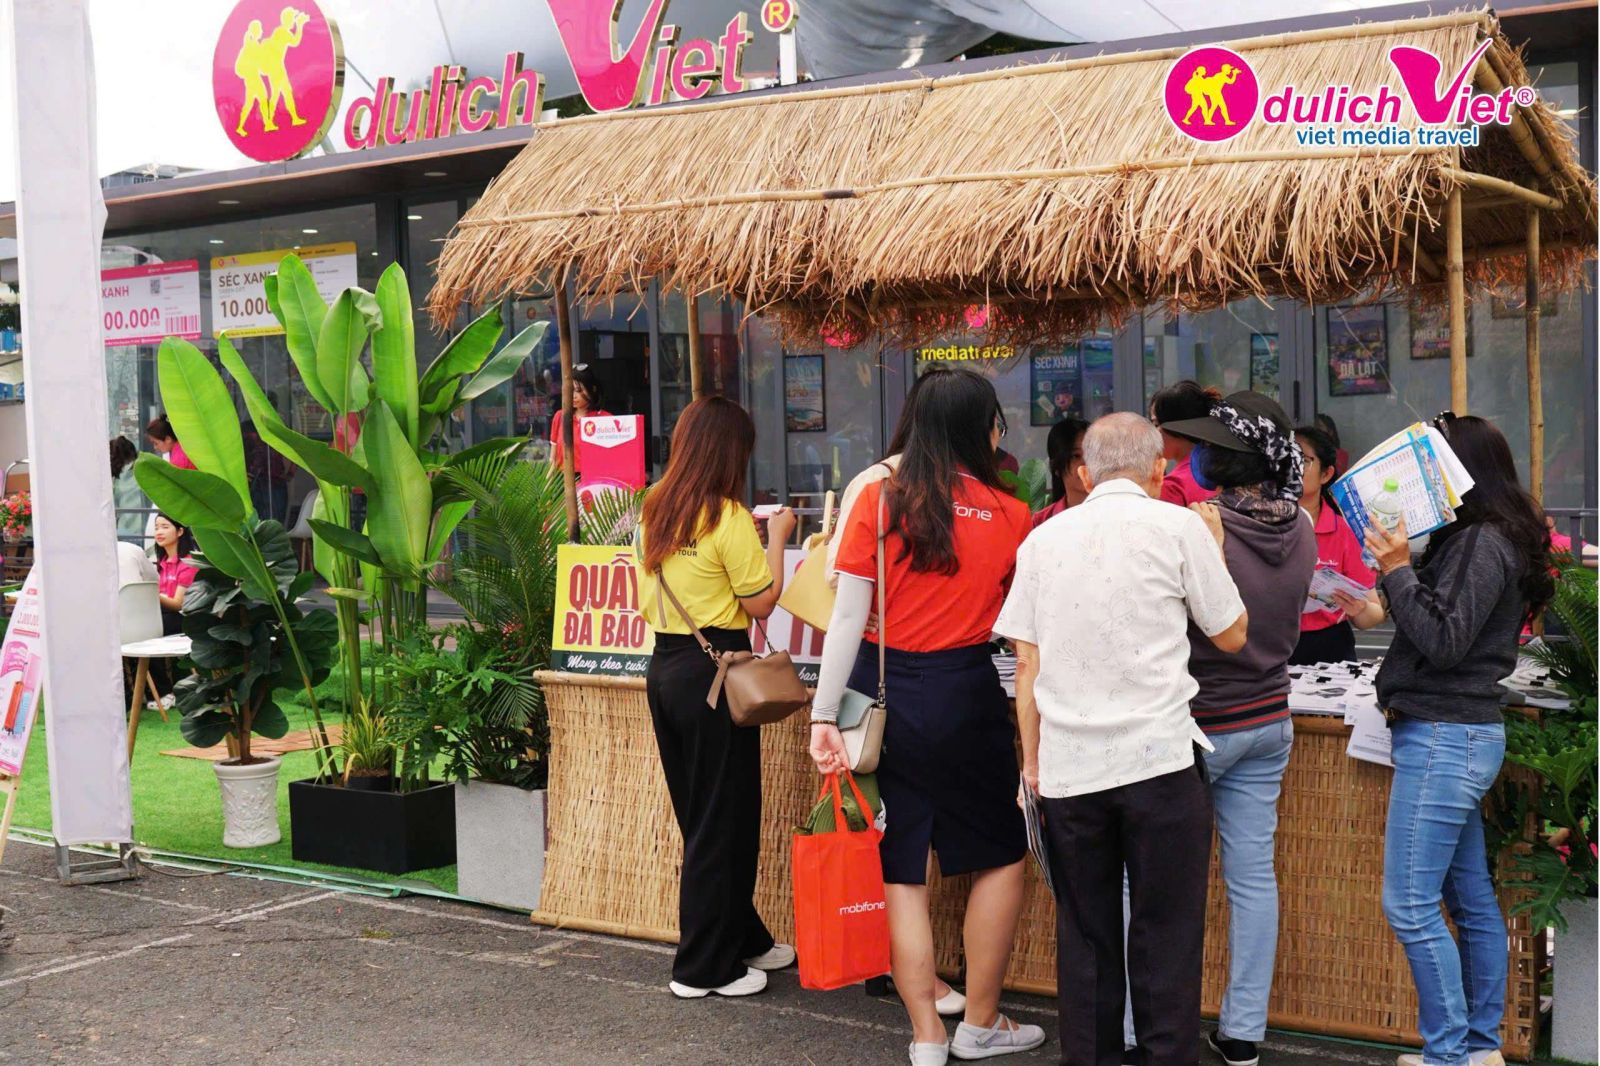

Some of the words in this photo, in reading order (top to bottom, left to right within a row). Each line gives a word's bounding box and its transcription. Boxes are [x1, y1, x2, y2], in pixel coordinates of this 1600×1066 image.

[344, 52, 543, 150] dulich
[218, 272, 240, 288] SÉC
[243, 269, 275, 285] XAN
[102, 285, 129, 298] XANH
[567, 655, 598, 674] Mang
[600, 656, 622, 670] theo
[840, 901, 886, 915] mobifone
